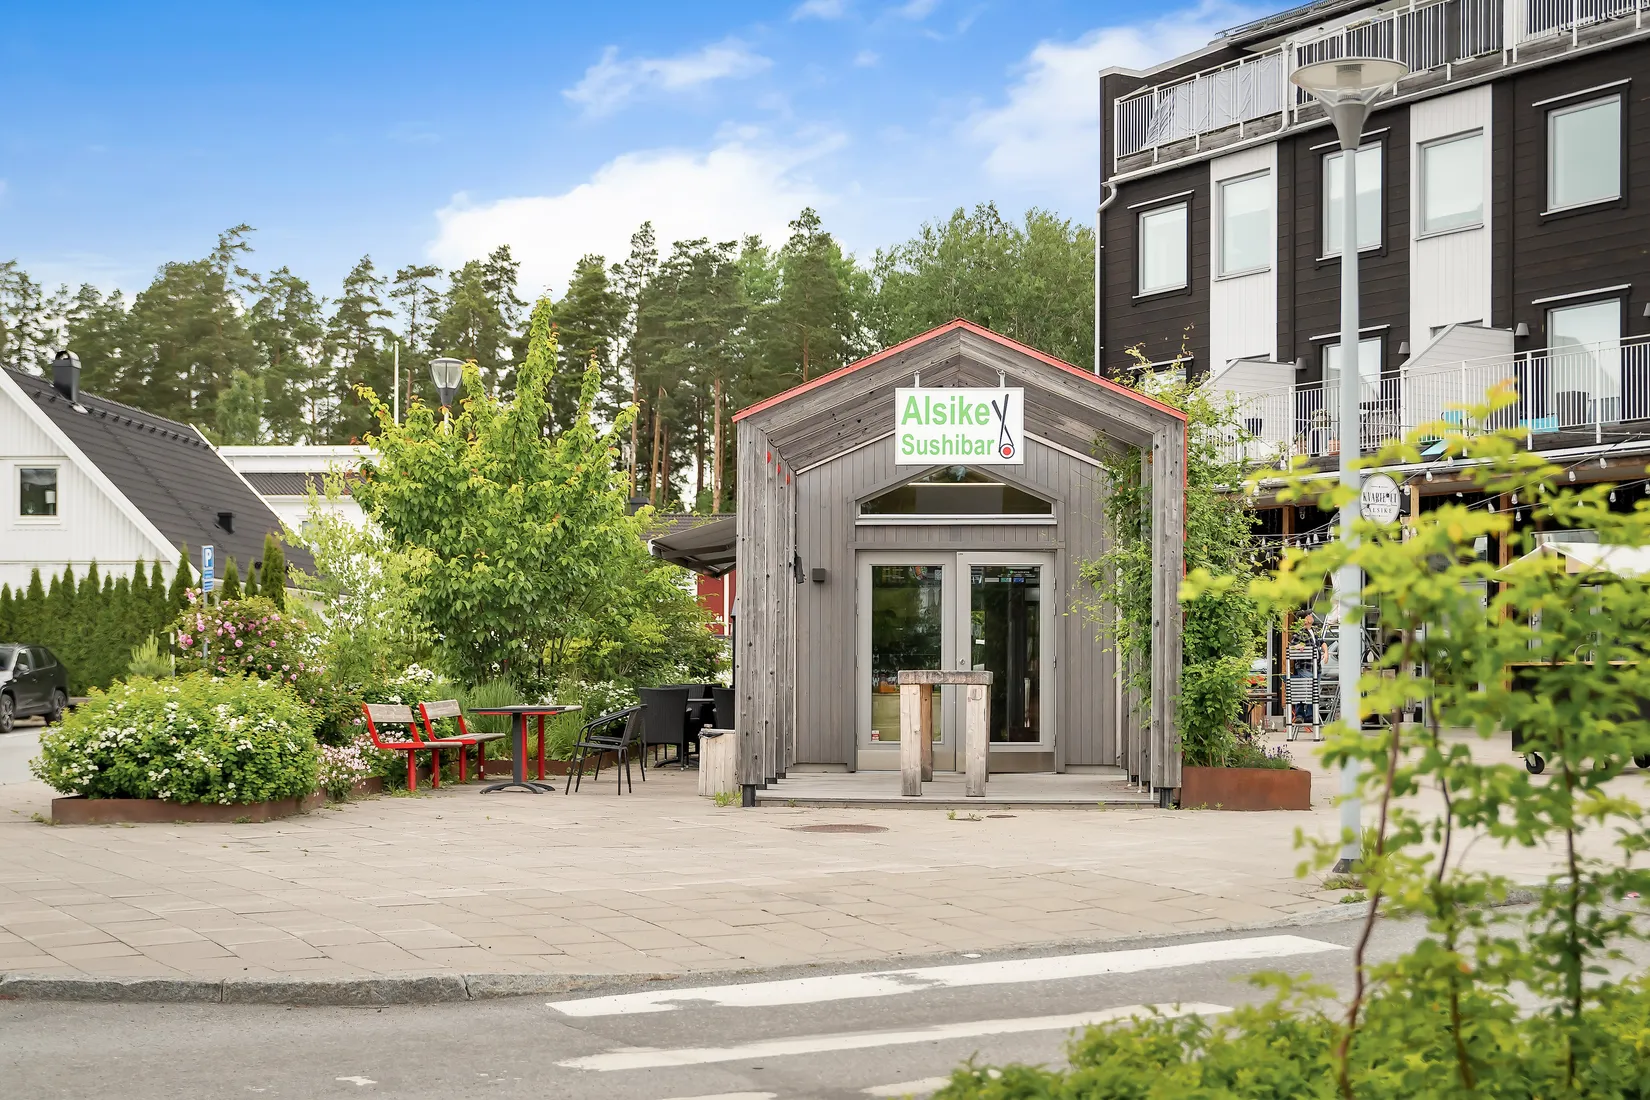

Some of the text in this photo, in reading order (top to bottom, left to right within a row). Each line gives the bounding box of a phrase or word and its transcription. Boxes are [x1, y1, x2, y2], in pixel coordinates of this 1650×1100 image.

[901, 395, 991, 425] Alsike
[901, 433, 995, 455] Sushibar
[1362, 491, 1397, 504] KVARTEET
[204, 548, 212, 567] P
